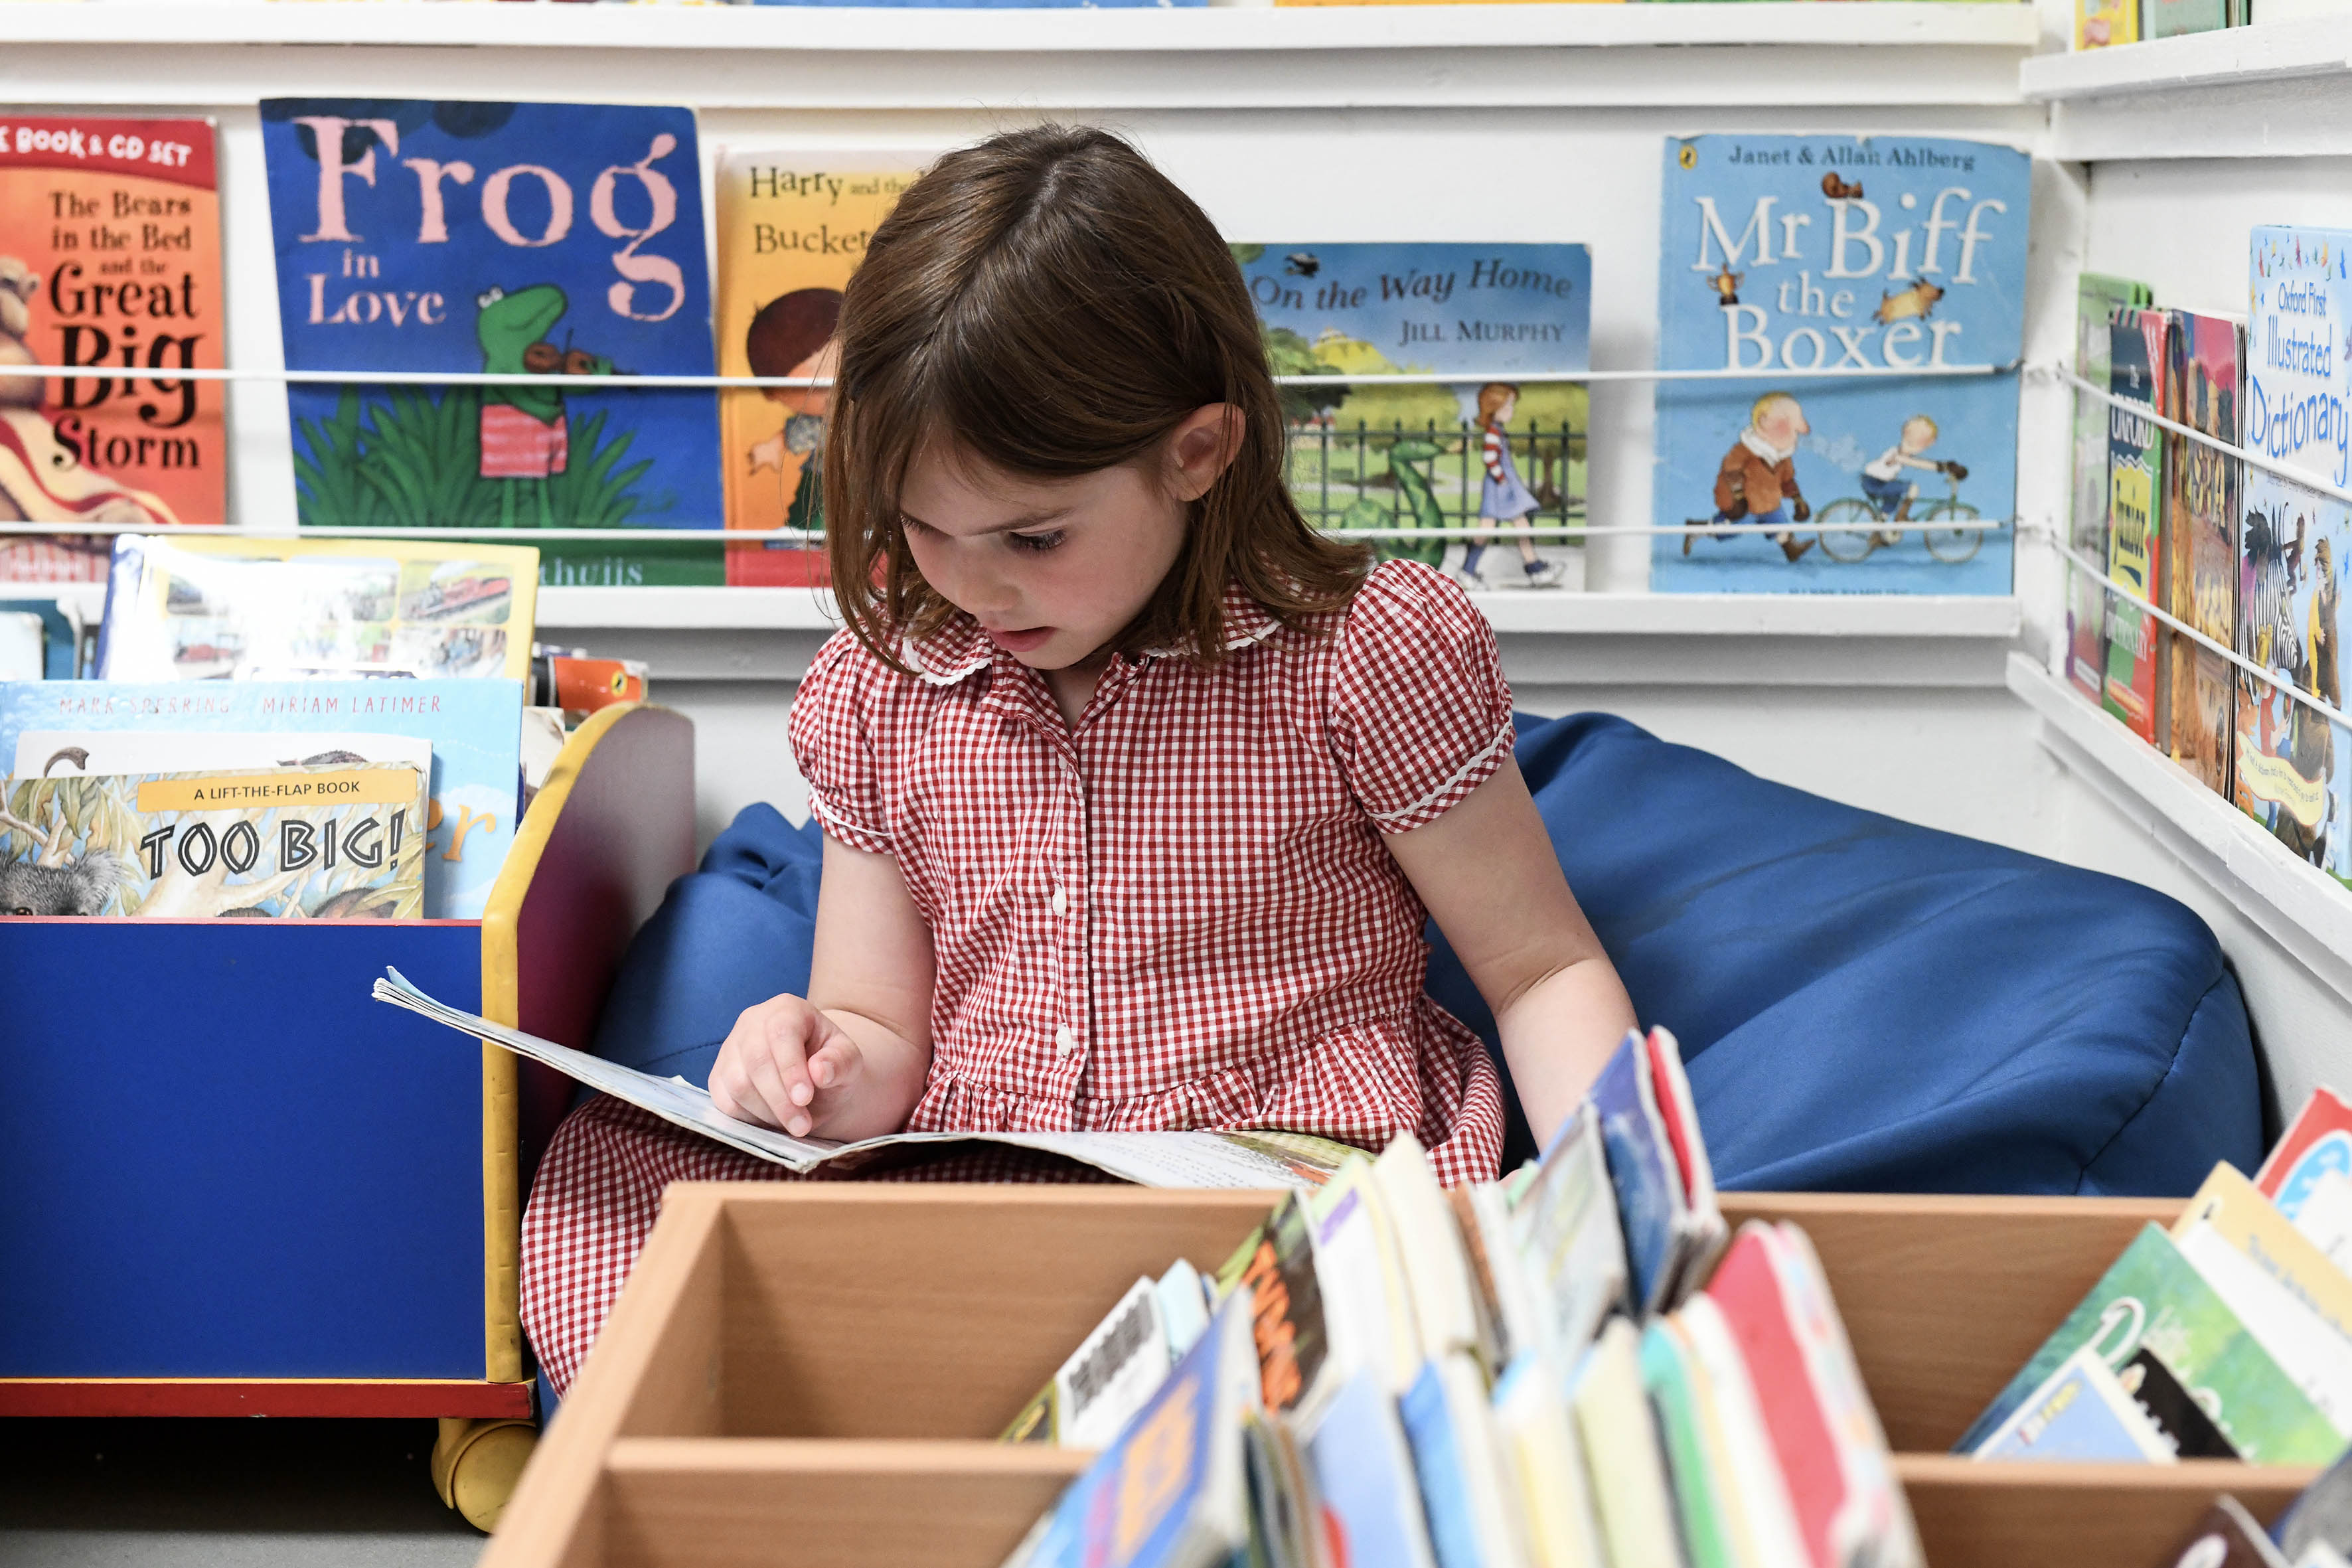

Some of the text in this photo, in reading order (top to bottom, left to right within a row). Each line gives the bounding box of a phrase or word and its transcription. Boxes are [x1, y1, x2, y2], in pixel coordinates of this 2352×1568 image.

[16, 126, 86, 159] BOOK
[89, 134, 103, 155] &
[108, 133, 145, 159] CD
[147, 140, 193, 167] SET
[1729, 145, 1976, 171] Janet & Allan Ahlberg
[49, 189, 191, 218] The Bears
[750, 166, 843, 206] Harry
[850, 177, 880, 194] and
[52, 222, 192, 251] in the Bed
[291, 116, 685, 321] Frog
[1691, 187, 2008, 285] Mr Biff
[100, 257, 166, 275] and the
[343, 248, 380, 278] in
[1250, 258, 1571, 310] On the Way Home
[50, 260, 200, 319] Great
[308, 272, 446, 327] Love
[1776, 270, 1855, 318] the
[2278, 279, 2327, 317] Oxford First
[1398, 320, 1566, 347] JILL MURPHY
[1720, 304, 1962, 369] Boxer
[2267, 314, 2332, 378] Illustrated
[52, 324, 206, 429] Big
[52, 414, 201, 471] Storm
[2250, 374, 2349, 488] Dictionary
[58, 698, 115, 715] MARK
[264, 697, 339, 714] MIRIAM
[352, 695, 441, 713] LATIMER
[195, 781, 360, 800] A LIFT-THE-FLAP BOOK
[140, 810, 405, 880] TOO BIG!
